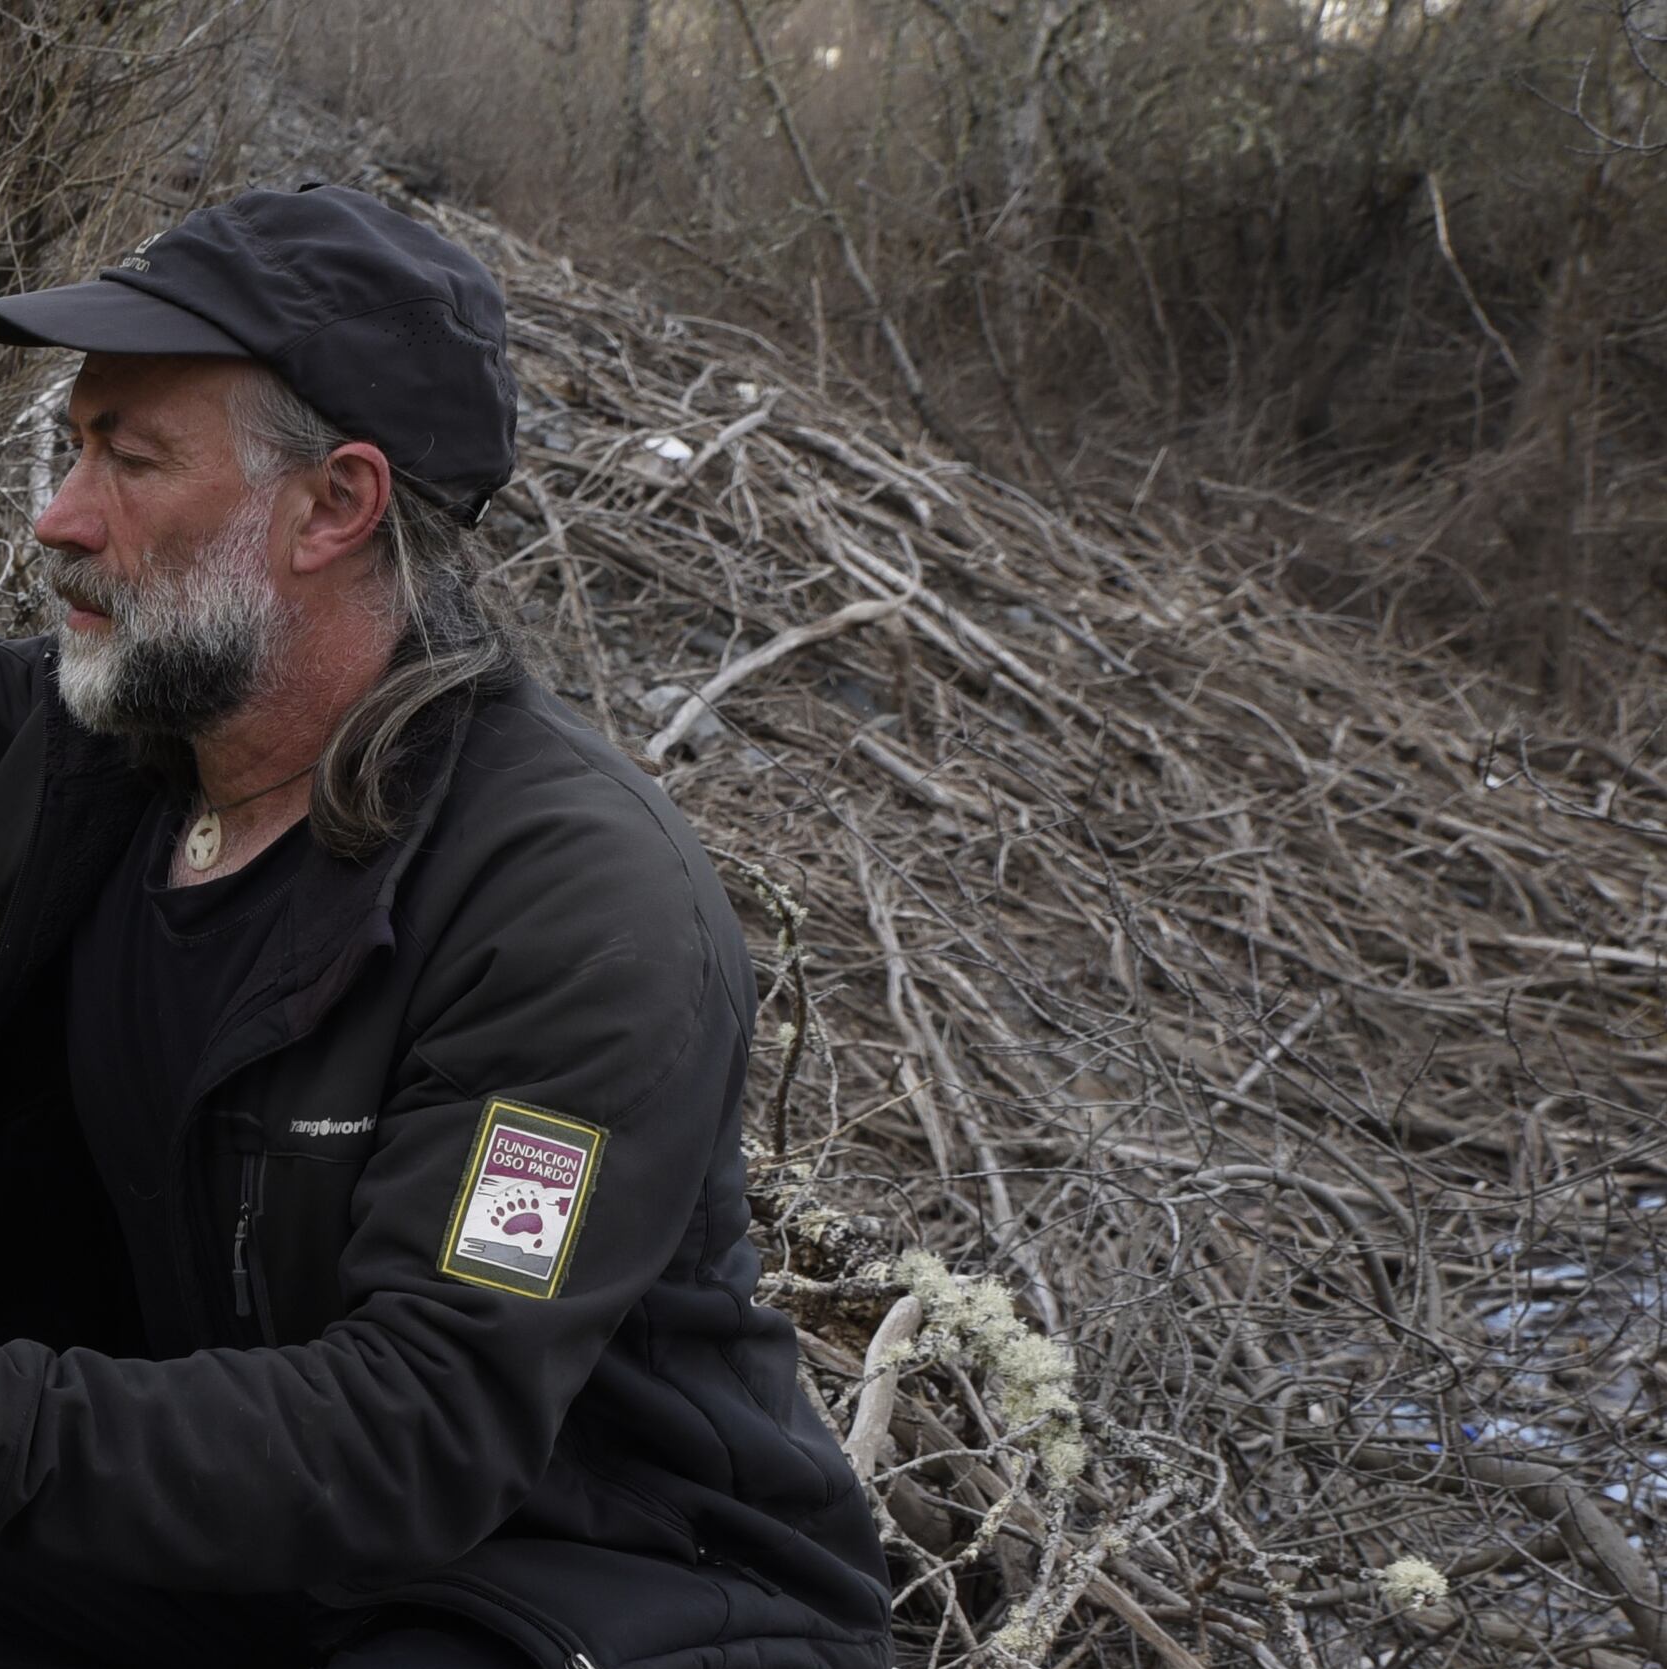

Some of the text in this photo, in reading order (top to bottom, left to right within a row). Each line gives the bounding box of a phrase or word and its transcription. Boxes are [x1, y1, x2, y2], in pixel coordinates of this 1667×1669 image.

[492, 1151, 575, 1185] OSO PARDO
[496, 1138, 579, 1172] FUNDACION
